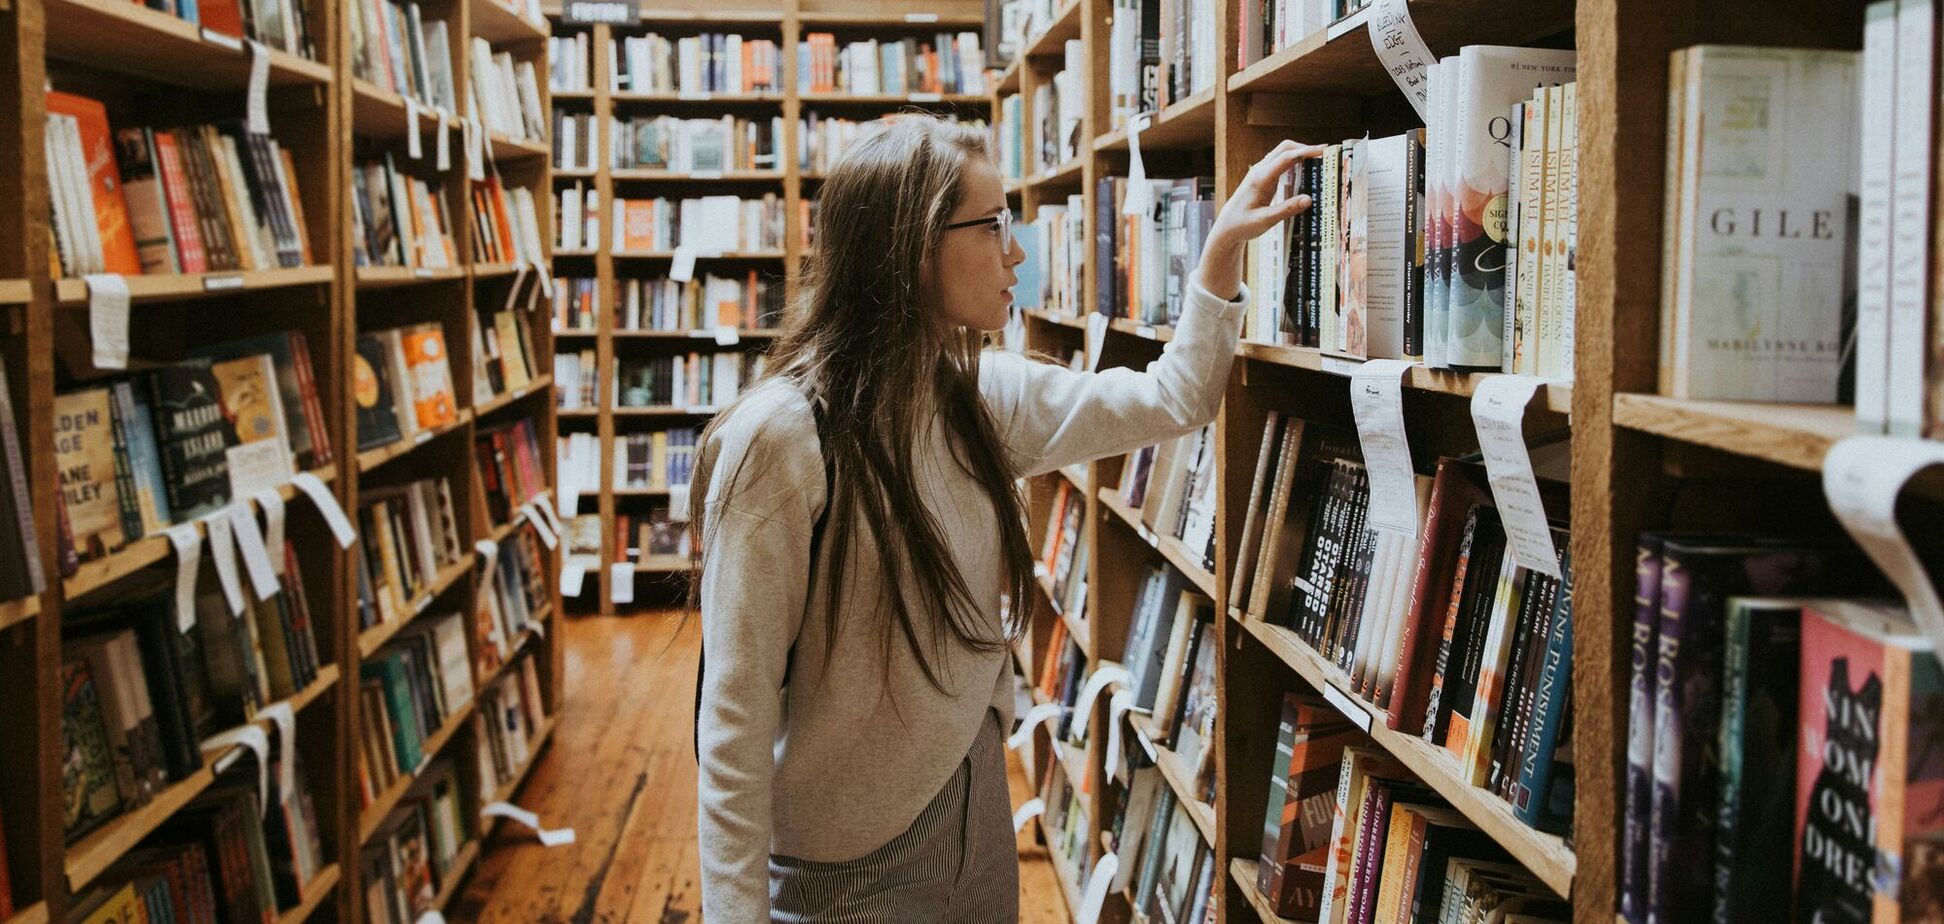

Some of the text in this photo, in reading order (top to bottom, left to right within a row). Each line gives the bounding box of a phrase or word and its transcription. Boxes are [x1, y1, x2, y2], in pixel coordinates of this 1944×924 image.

[1541, 64, 1561, 72] YORK
[1406, 139, 1415, 233] Monument Road
[1527, 149, 1541, 224] ISHMAEL
[1544, 149, 1557, 226] ISHMAEL
[1559, 148, 1570, 225] ISHMAEL
[1451, 202, 1460, 256] MILLER'S
[1711, 207, 1836, 242] GILE
[1525, 260, 1534, 299] DANIEL
[1541, 263, 1551, 302] DANIEL
[1555, 263, 1563, 302] DANIEL
[1503, 260, 1514, 341] Anna Quindlen
[1422, 506, 1436, 540] Devil
[1310, 538, 1332, 612] OTARED
[1317, 542, 1339, 617] OTARED
[1406, 554, 1426, 616] Jerusalem
[1539, 580, 1548, 601] WHY
[1547, 583, 1556, 605] WHY
[1521, 590, 1533, 626] RAKHA
[1531, 611, 1541, 634] CAME
[1539, 614, 1549, 639] CAME
[1459, 648, 1471, 680] Childhood
[1467, 652, 1479, 684] Childhood
[1521, 568, 1577, 777] DIVINE PUNISHMENT
[1499, 646, 1522, 729] the CROCODILES
[1822, 684, 1873, 740] NIN
[1353, 801, 1369, 873] UNRESTORED
[1363, 810, 1380, 883] UNRESTORED
[1346, 876, 1358, 918] WOMAN
[1403, 868, 1411, 888] RON
[1398, 891, 1407, 918] RASH
